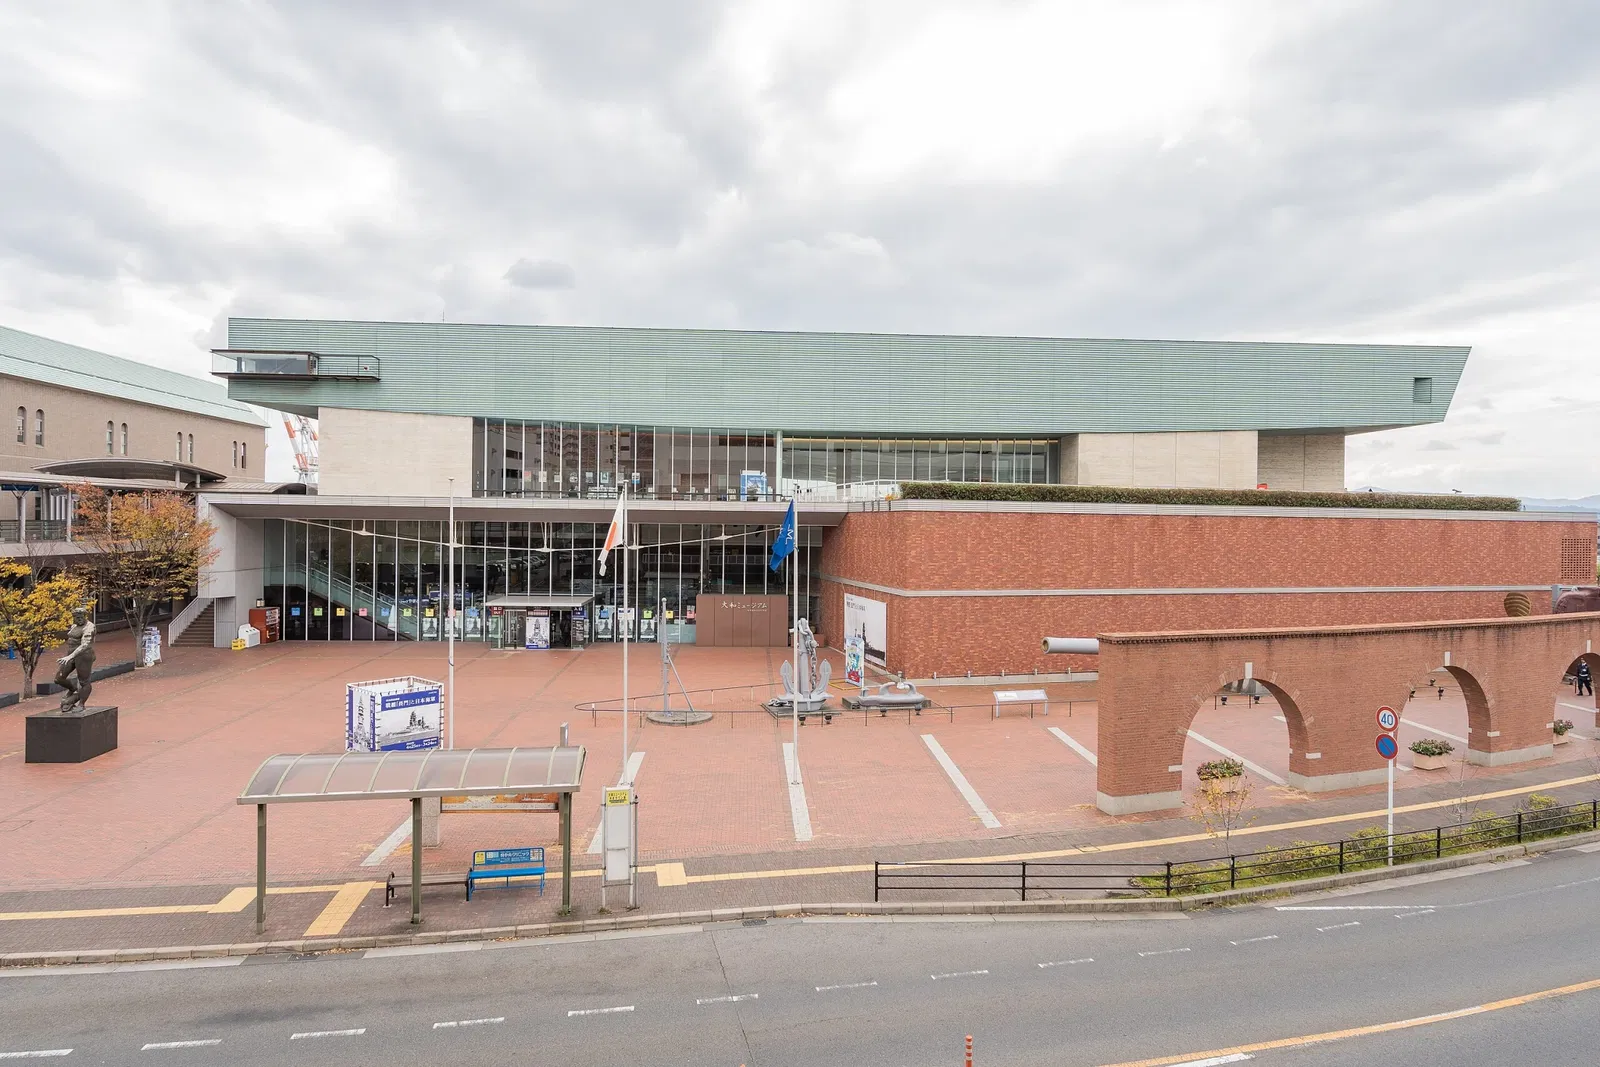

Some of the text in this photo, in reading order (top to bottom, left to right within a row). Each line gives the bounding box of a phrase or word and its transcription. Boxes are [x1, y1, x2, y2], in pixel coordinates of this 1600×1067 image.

[720, 600, 768, 609] 大和ミュージアム
[1381, 713, 1394, 726] 40
